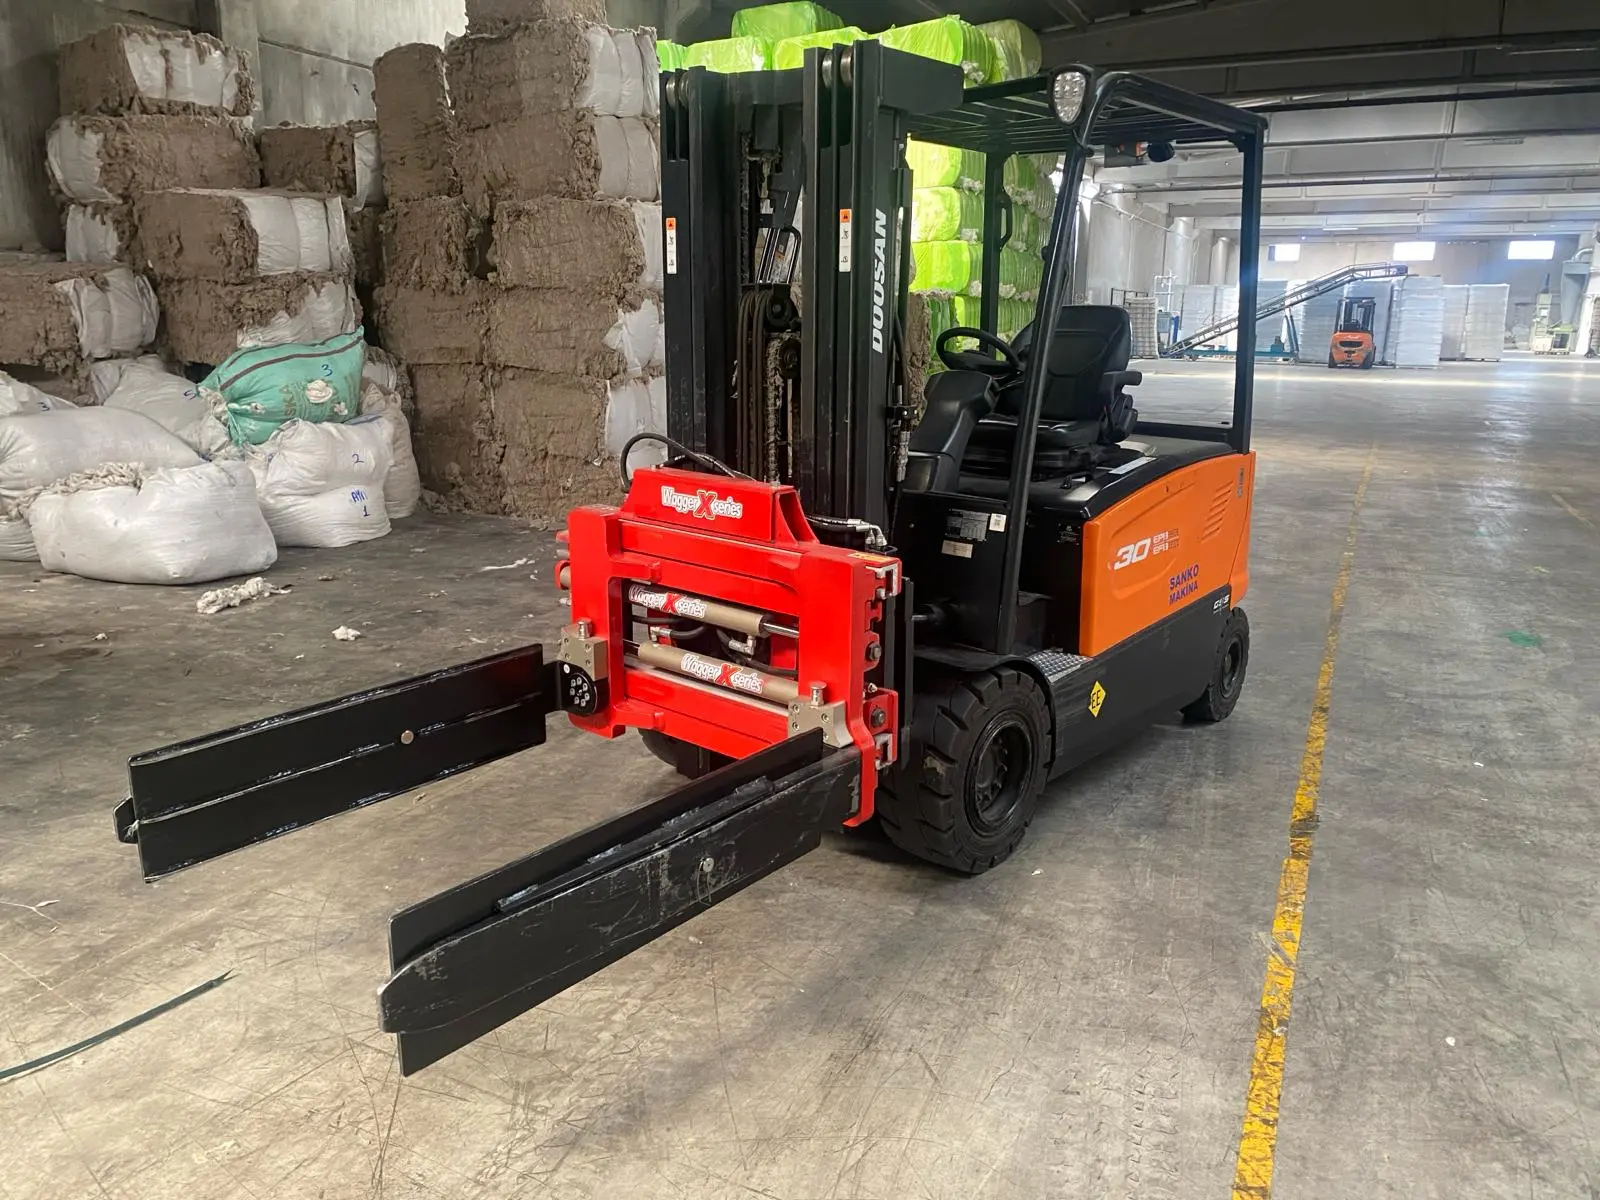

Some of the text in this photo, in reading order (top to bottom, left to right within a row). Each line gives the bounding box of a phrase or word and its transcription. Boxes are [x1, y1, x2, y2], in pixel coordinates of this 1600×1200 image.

[872, 208, 887, 353] DOOSAN
[321, 364, 333, 377] 3
[352, 453, 364, 464] 2
[363, 505, 370, 517] 1
[1113, 537, 1152, 570] 30
[1169, 564, 1199, 590] SANKO
[1091, 689, 1101, 709] EE
